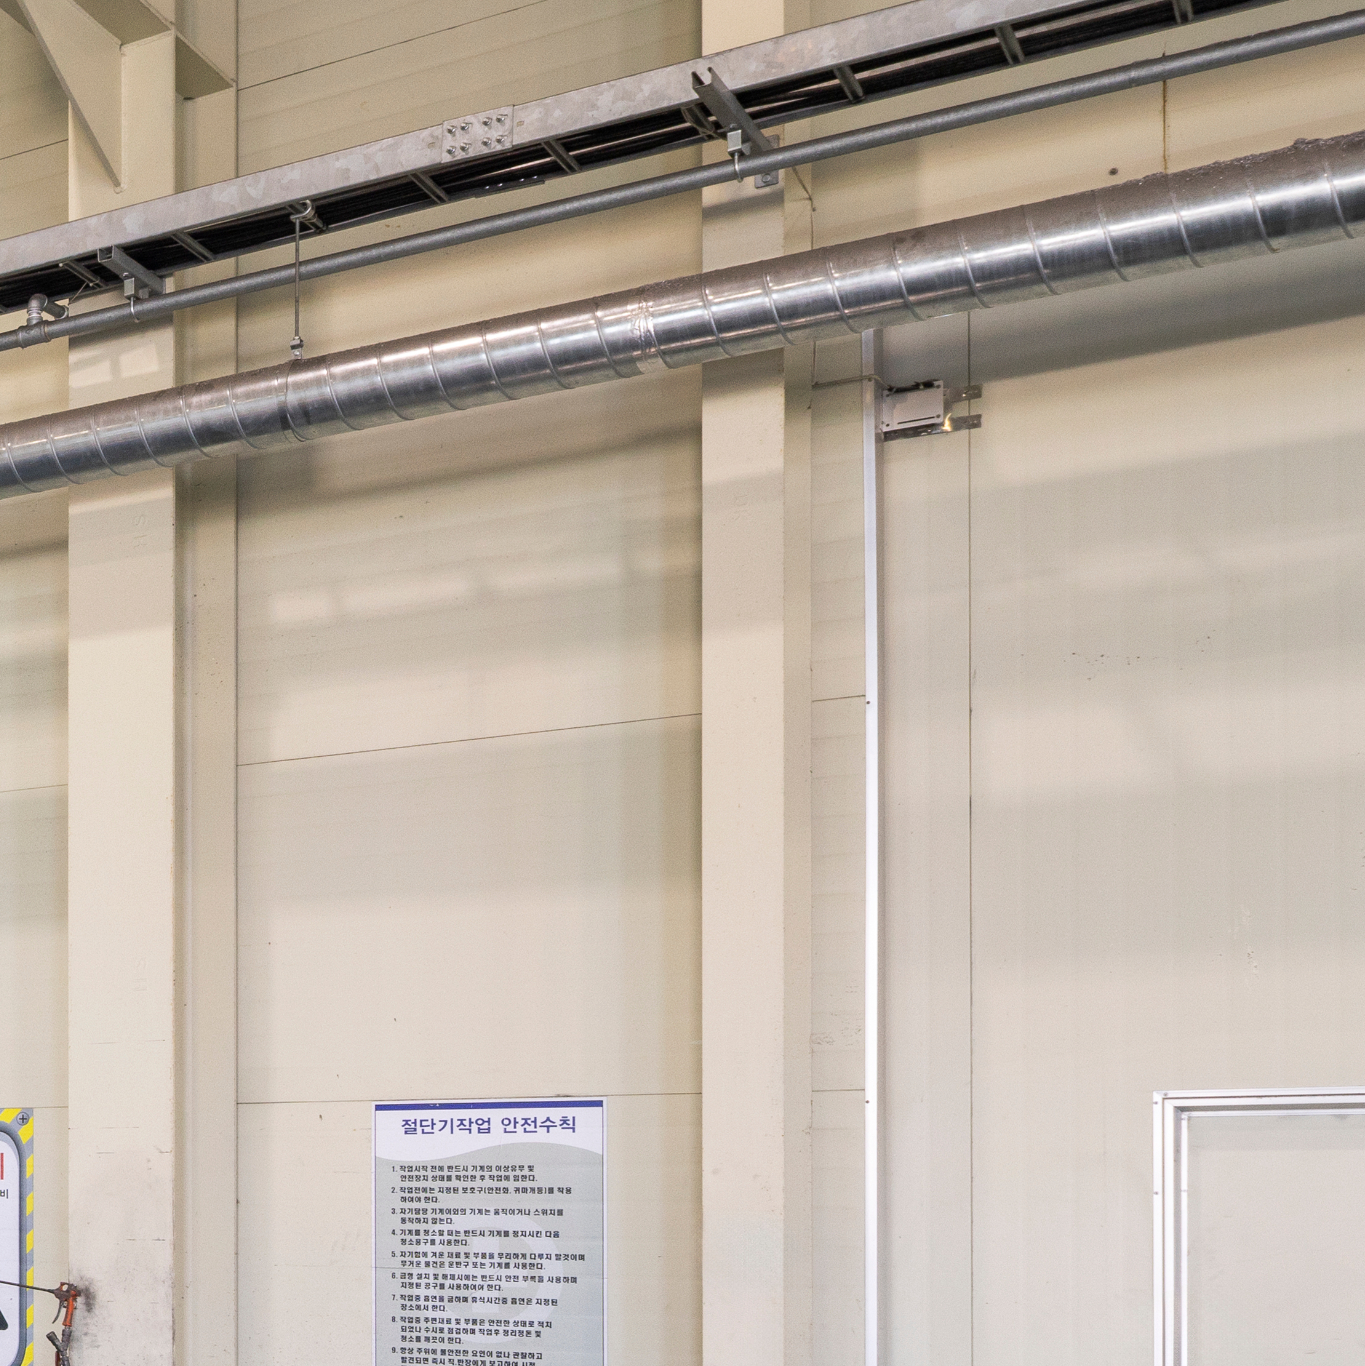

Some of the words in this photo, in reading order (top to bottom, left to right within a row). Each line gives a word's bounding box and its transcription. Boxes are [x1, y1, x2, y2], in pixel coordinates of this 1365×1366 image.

[401, 1117, 492, 1135] 절단기작업
[501, 1115, 576, 1134] 안전수칙
[547, 1276, 577, 1284] 사용하며
[536, 1298, 558, 1306] 지정된
[400, 1316, 421, 1324] 작업중
[488, 1319, 510, 1327] 안전한
[478, 1328, 499, 1336] 작업후
